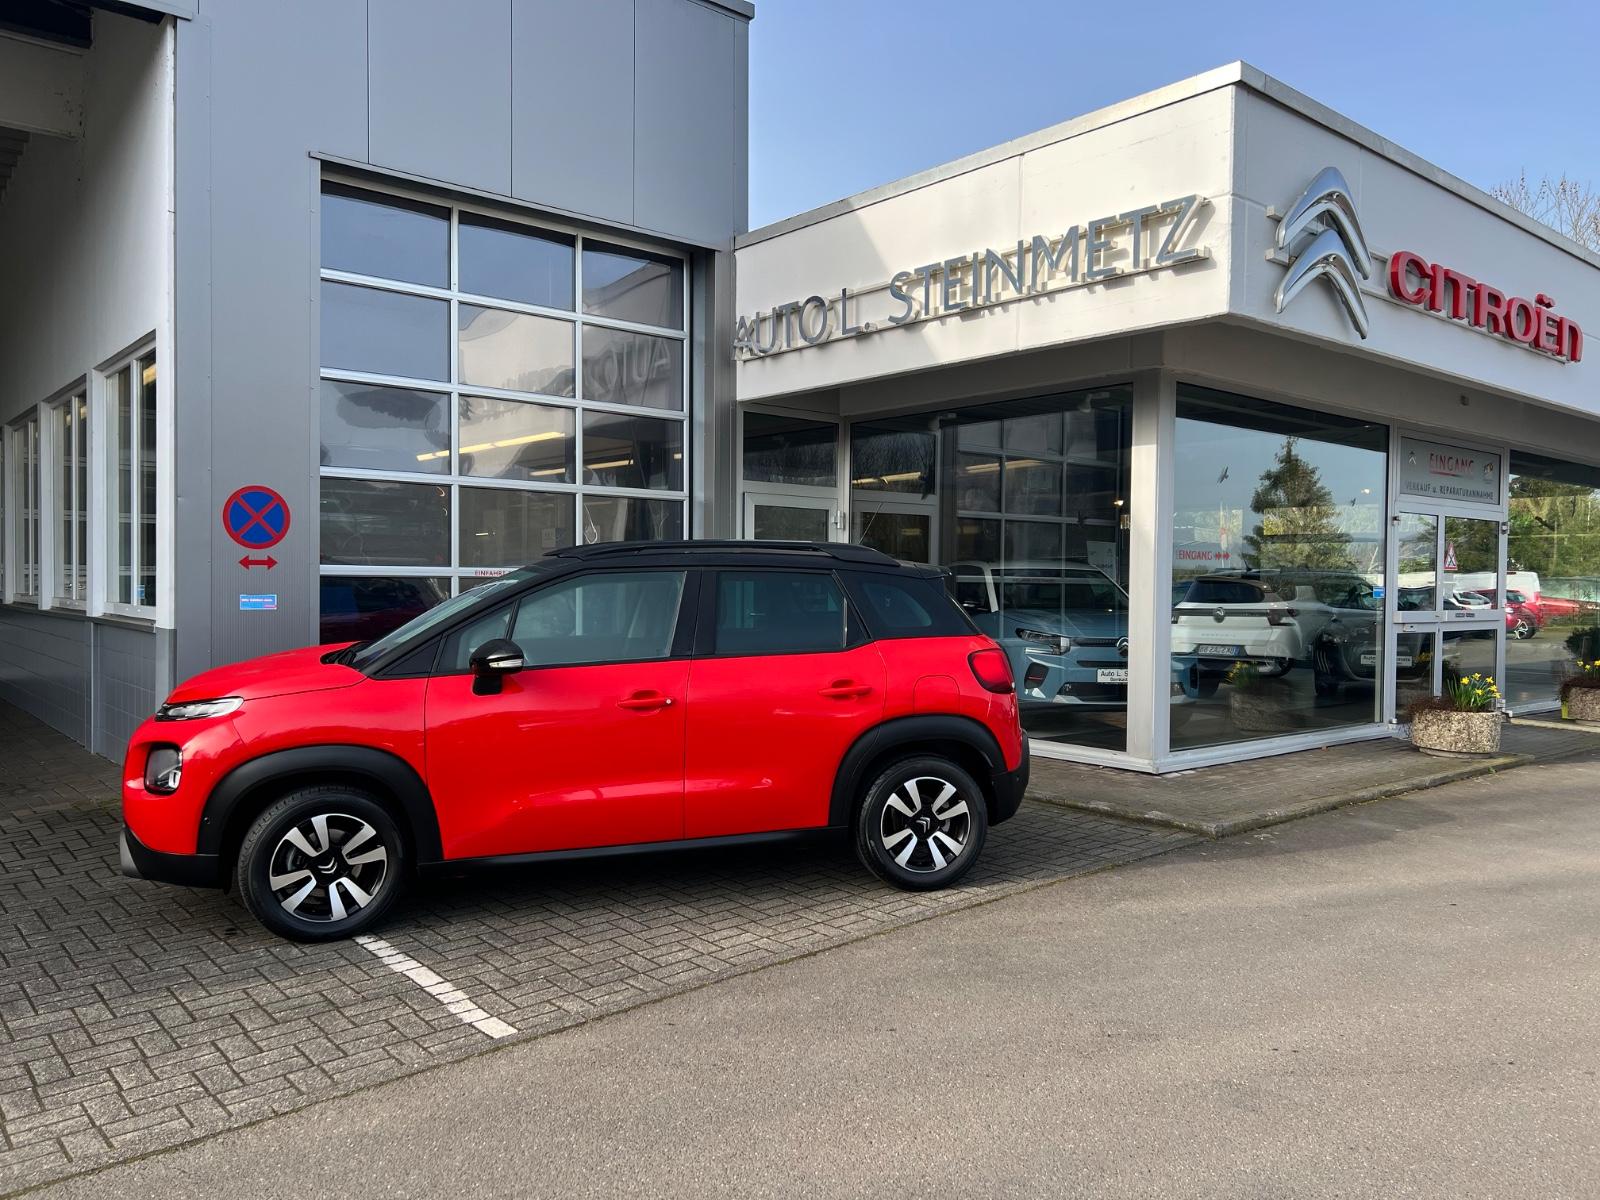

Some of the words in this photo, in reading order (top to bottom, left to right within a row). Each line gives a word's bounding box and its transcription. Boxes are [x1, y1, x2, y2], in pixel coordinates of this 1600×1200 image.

[733, 296, 828, 357] AUTO
[841, 288, 876, 334] L.
[889, 195, 1206, 325] STEINMETZ
[1178, 550, 1213, 561] EINGANG
